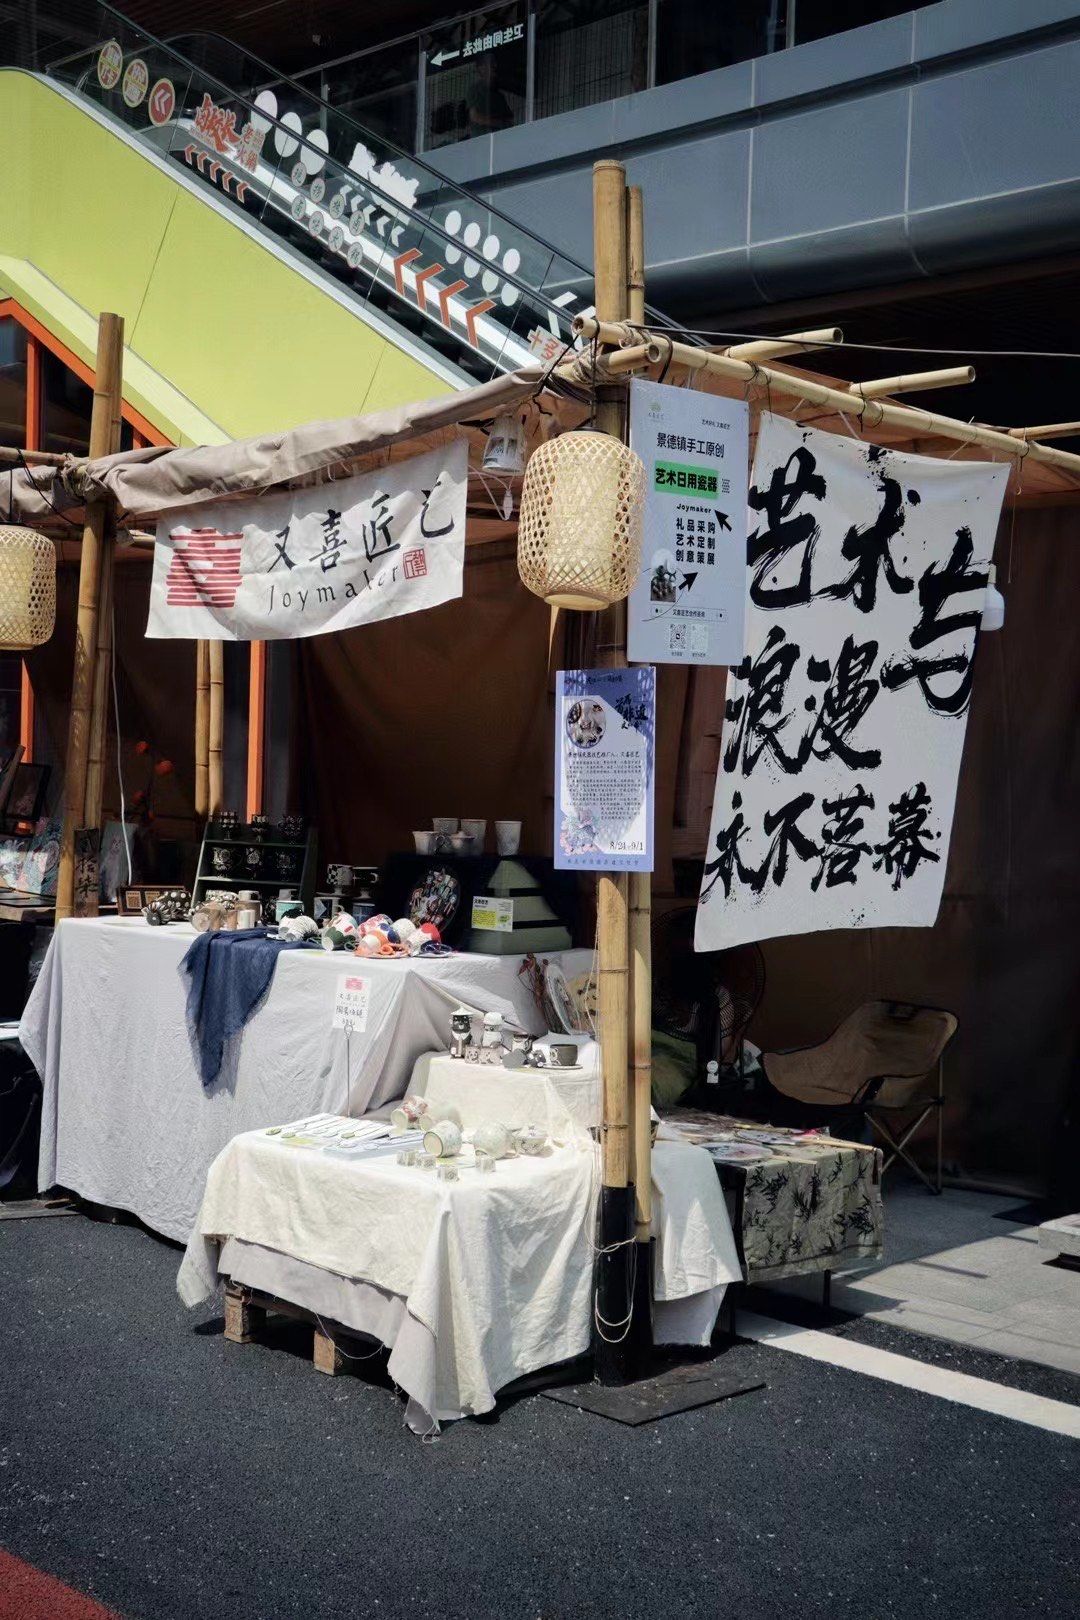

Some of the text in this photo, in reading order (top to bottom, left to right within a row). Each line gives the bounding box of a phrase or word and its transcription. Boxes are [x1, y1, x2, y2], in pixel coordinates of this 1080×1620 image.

[656, 432, 725, 458] 景德镇手工原创
[655, 467, 718, 492] 艺术日用瓷器
[676, 503, 712, 514] Joymaker
[676, 517, 716, 534] 礼品采购
[676, 533, 716, 550] 艺术定制
[675, 549, 715, 565] 创意策展
[724, 625, 881, 778] 浪漫
[699, 782, 942, 903] 永不落幕
